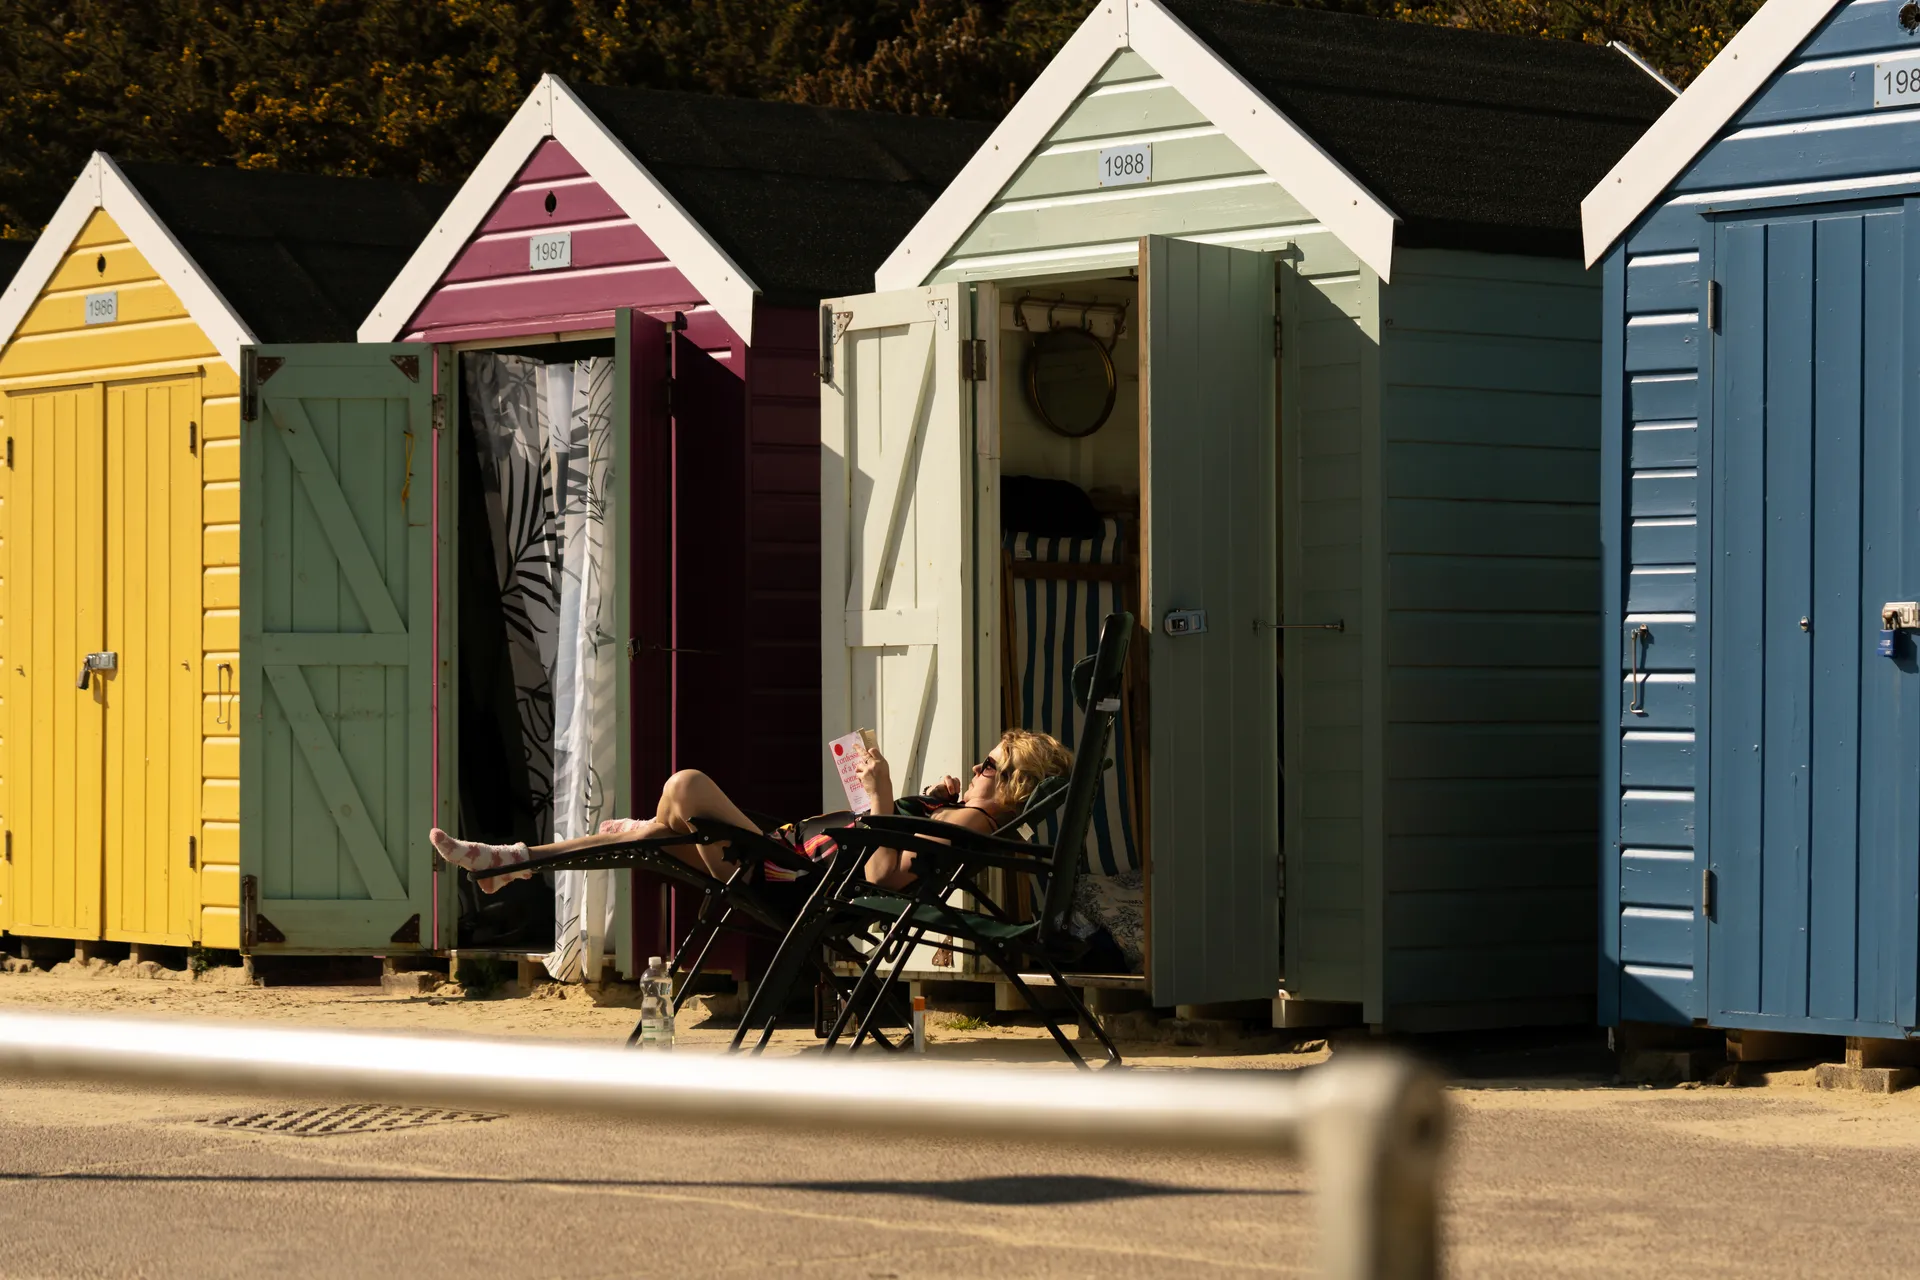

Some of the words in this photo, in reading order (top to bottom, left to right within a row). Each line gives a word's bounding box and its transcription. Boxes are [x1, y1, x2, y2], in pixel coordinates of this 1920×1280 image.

[1105, 153, 1144, 177] 1988
[535, 241, 566, 262] 1987
[89, 298, 113, 317] 1986
